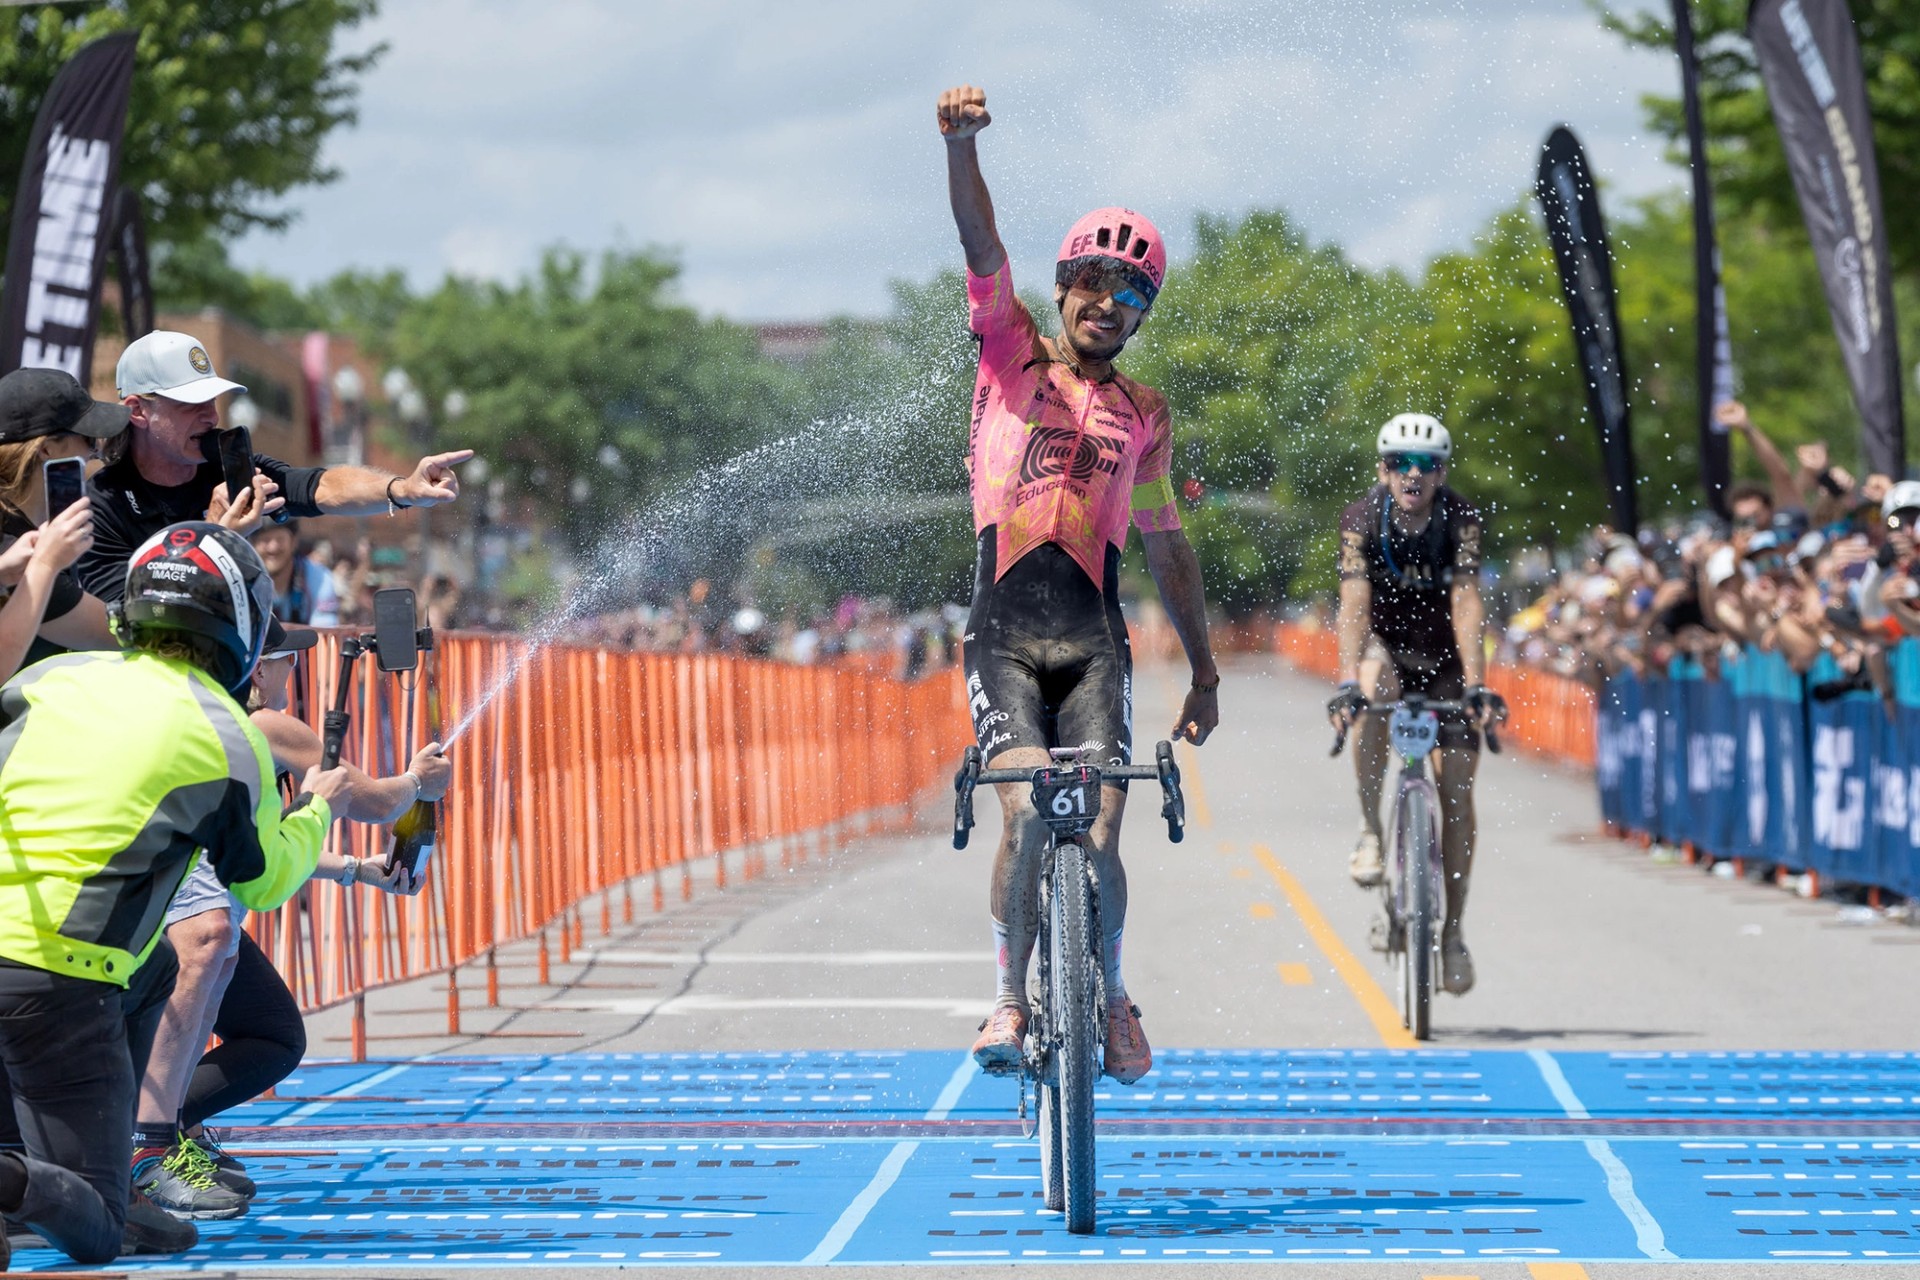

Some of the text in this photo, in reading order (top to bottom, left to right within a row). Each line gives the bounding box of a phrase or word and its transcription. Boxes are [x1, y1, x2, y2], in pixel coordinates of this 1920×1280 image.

[25, 122, 110, 334] TIME
[1045, 396, 1077, 415] NIPPO
[1093, 404, 1134, 420] easypost
[1095, 417, 1130, 433] wahoo
[1015, 478, 1087, 508] Education
[146, 561, 199, 575] COMPETITIVE
[152, 569, 187, 582] IMAGE
[1052, 787, 1086, 816] 61
[479, 1187, 601, 1195] TIME
